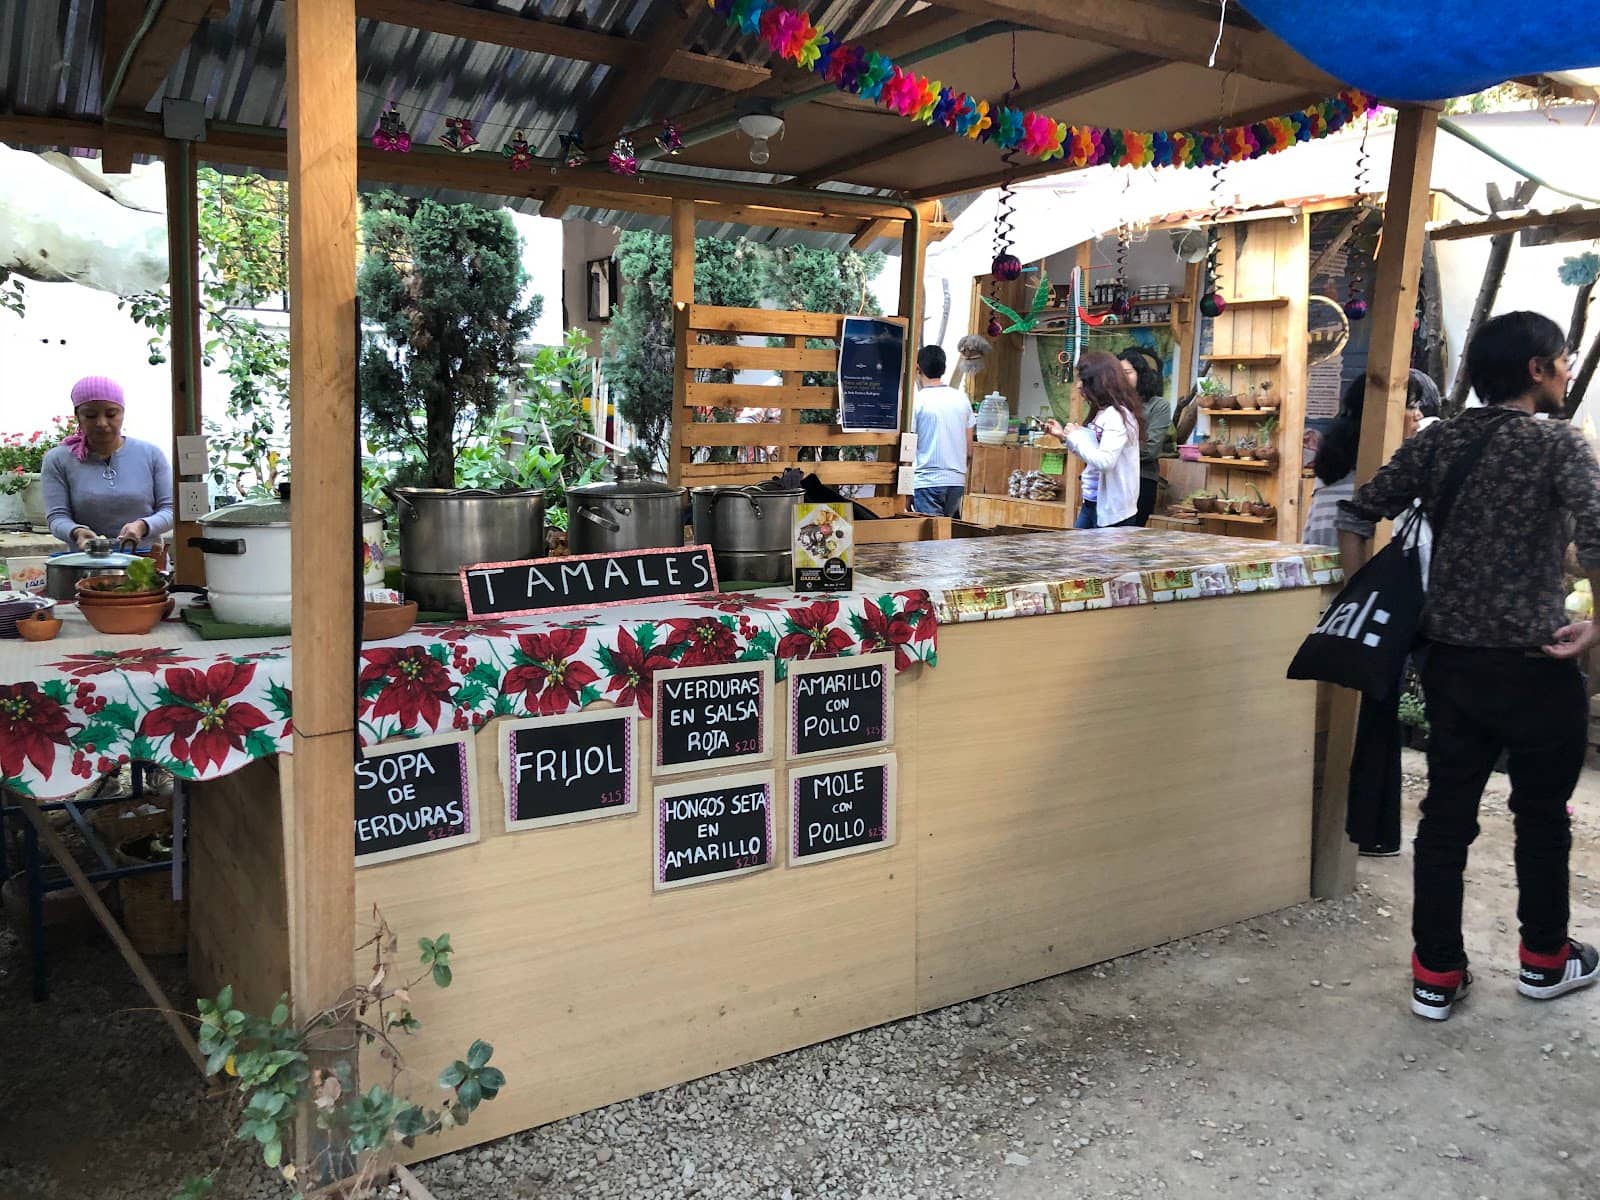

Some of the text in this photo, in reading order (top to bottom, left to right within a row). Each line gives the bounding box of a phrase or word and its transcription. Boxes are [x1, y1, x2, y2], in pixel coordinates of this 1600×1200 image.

[468, 555, 709, 605] TAMALES
[665, 677, 760, 700] VERDURAS
[797, 669, 881, 698] AMARILLO
[670, 699, 759, 726] EN SALSA
[825, 697, 850, 713] CON
[804, 714, 860, 737] POLLO
[687, 729, 730, 757] ROJA
[735, 738, 756, 753] $20
[354, 751, 436, 790] SOPA
[516, 744, 623, 787] FRIJOL
[387, 783, 416, 805] DE
[813, 771, 865, 800] MOLE
[665, 791, 766, 822] HONGOS SETA
[832, 800, 853, 814] CON
[697, 822, 719, 839] EN
[808, 818, 865, 847] POLLO
[664, 836, 761, 869] AMARILLO
